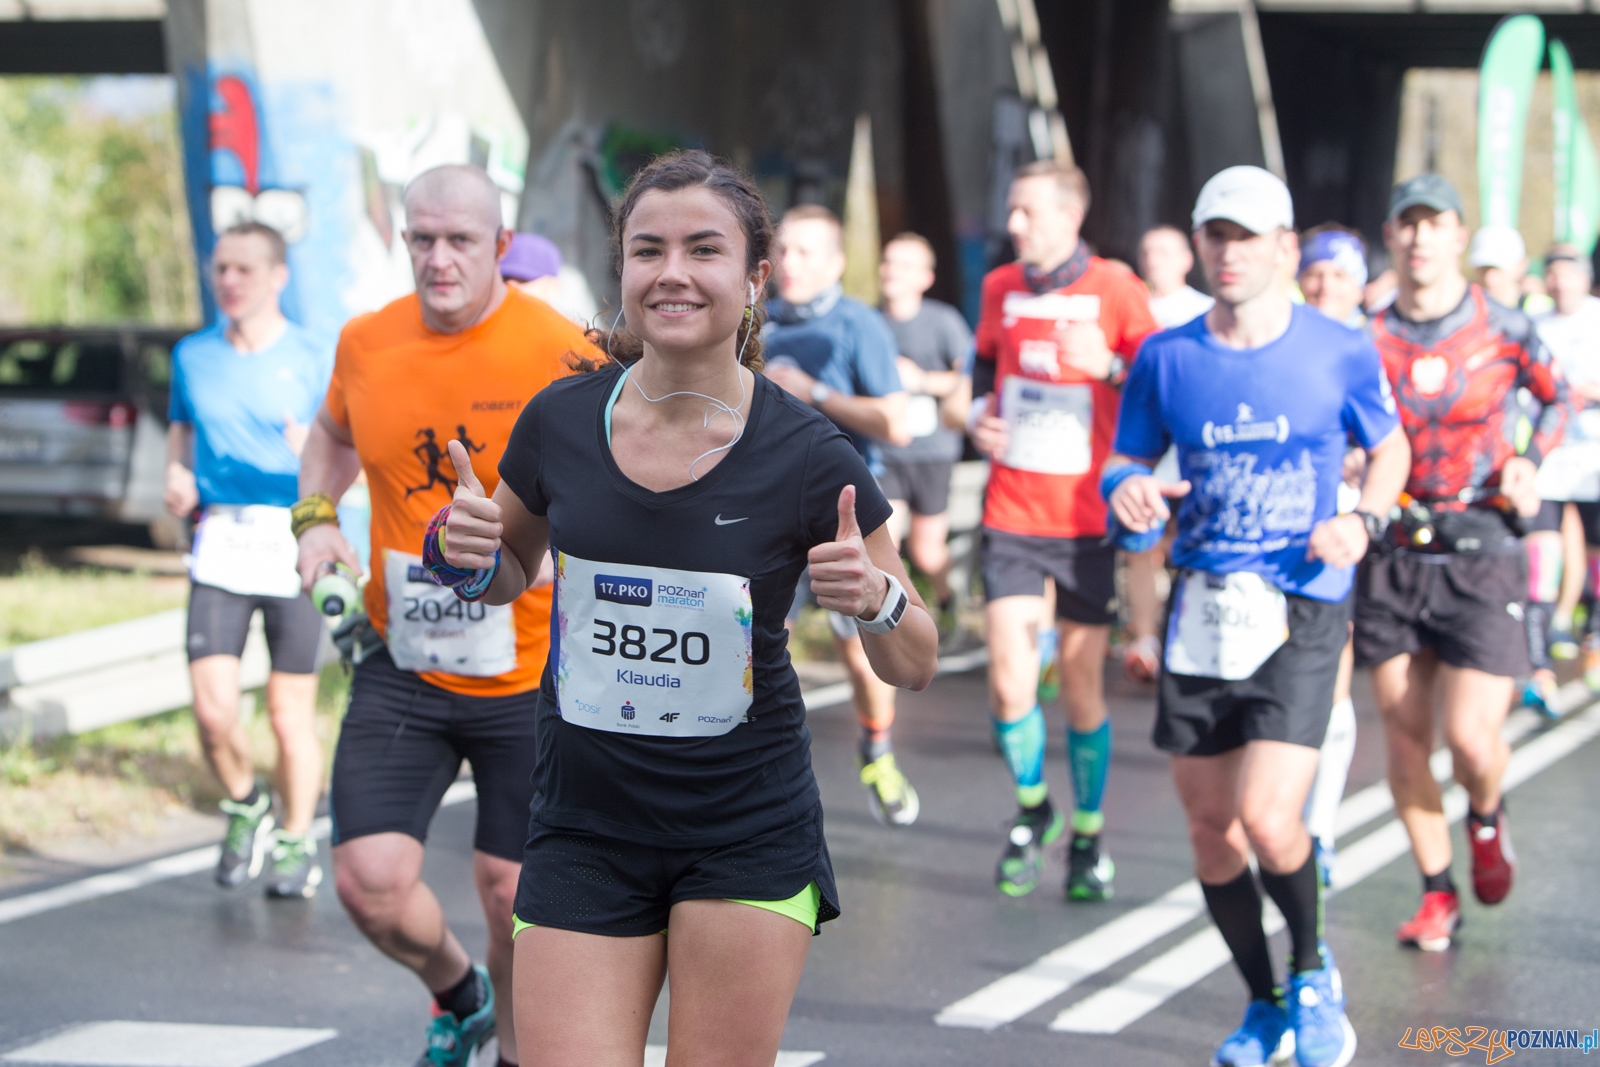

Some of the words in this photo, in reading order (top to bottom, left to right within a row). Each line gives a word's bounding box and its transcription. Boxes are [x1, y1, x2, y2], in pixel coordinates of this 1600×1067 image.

[403, 597, 486, 623] 2040
[657, 595, 705, 607] maraton
[592, 618, 710, 666] 3820
[616, 668, 681, 688] Klaudia
